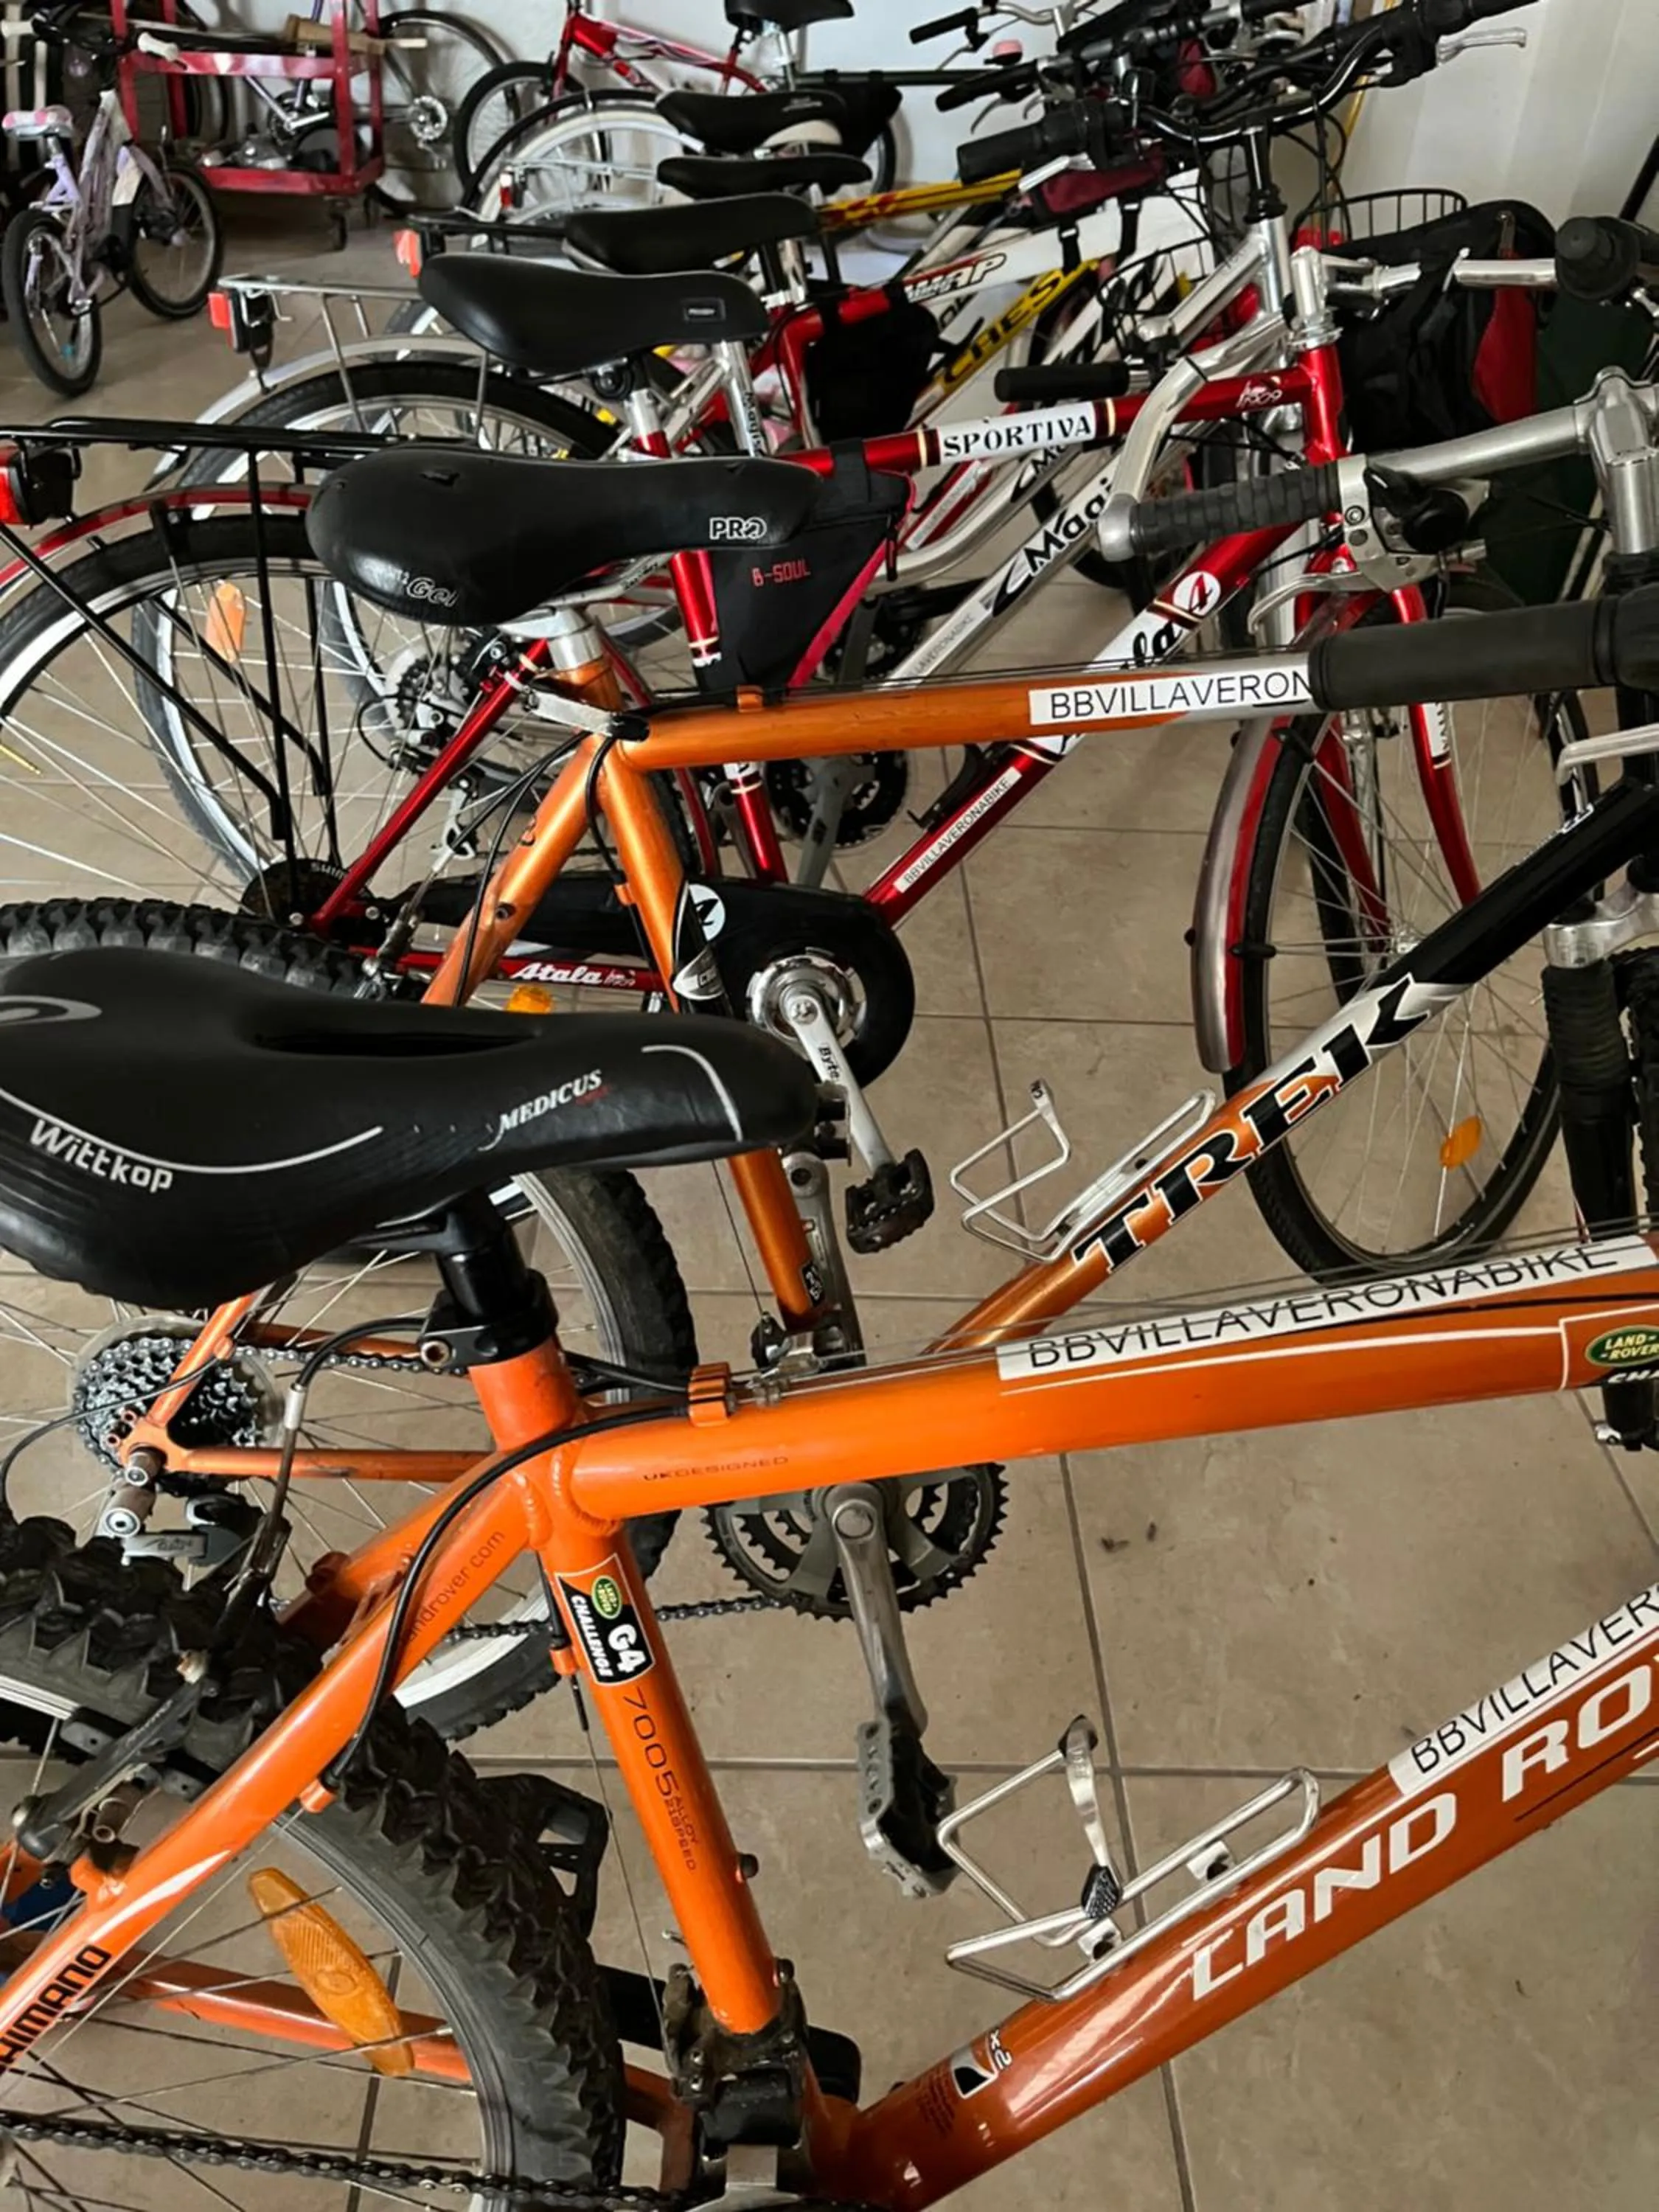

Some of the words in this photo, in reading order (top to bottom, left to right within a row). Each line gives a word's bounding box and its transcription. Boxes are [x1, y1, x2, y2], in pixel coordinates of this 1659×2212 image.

[944, 415, 1091, 457] SPORTIVA
[406, 577, 459, 607] Gel
[903, 777, 1009, 882] BBVILLAVERONABIKE
[510, 962, 602, 984] Atala
[30, 1119, 173, 1194] Wittkop
[478, 1068, 602, 1151] MEDICUS
[1072, 973, 1430, 1273] TREK
[1030, 1243, 1618, 1368] BBVILLAVERONABIKE
[571, 1595, 613, 1677] CHALLENGE
[608, 1624, 647, 1673] G4
[1411, 1587, 1659, 1774] BBVILLAVER
[623, 1686, 680, 1796] 7005
[1193, 1792, 1458, 2002] LAND
[1502, 1656, 1659, 1803] RO
[0, 1944, 112, 2065] HIMANO
